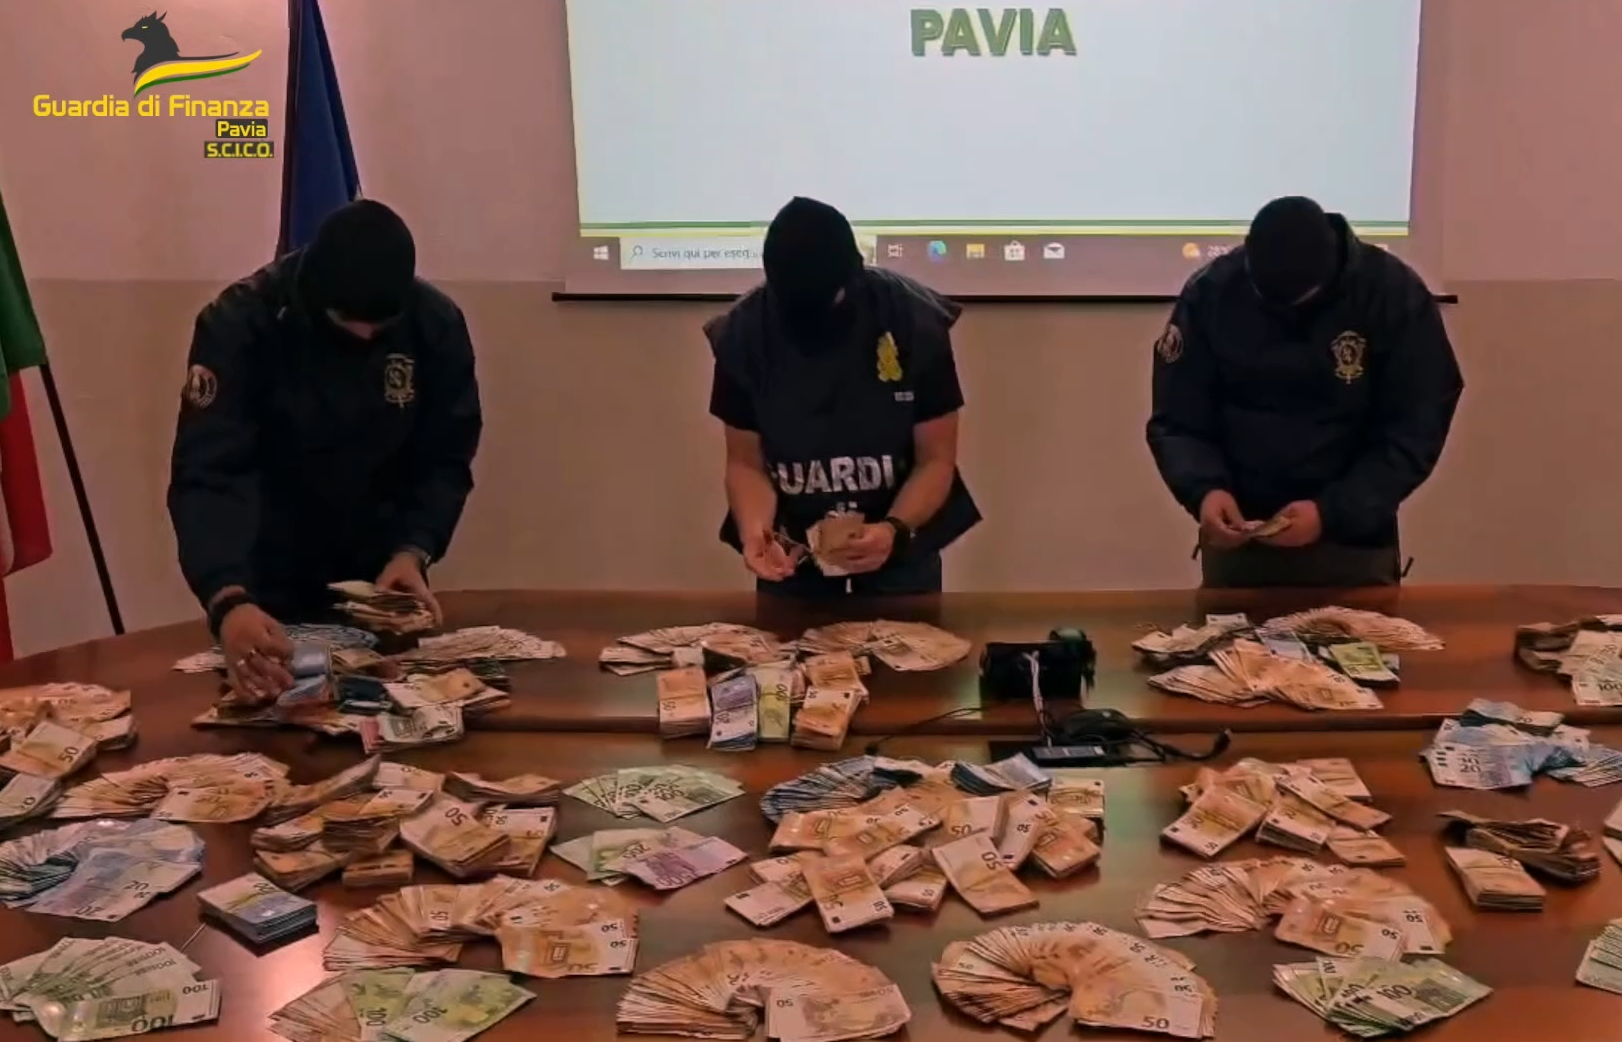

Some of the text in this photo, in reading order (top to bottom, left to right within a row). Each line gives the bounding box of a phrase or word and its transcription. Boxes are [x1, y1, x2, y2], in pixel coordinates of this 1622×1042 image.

[911, 8, 1077, 56] PAVIA
[652, 247, 681, 259] Scrivi
[684, 248, 700, 260] qui
[704, 249, 721, 261] per
[777, 455, 894, 495] UARDI
[59, 746, 79, 763] 50
[1460, 765, 1481, 773] 20
[445, 806, 468, 827] 50
[951, 824, 971, 835] 50
[981, 851, 1002, 870] 50
[601, 924, 618, 933] 50
[182, 983, 209, 995] 100
[776, 999, 793, 1008] 50
[131, 1015, 174, 1034] 100
[1142, 1016, 1169, 1029] 50
